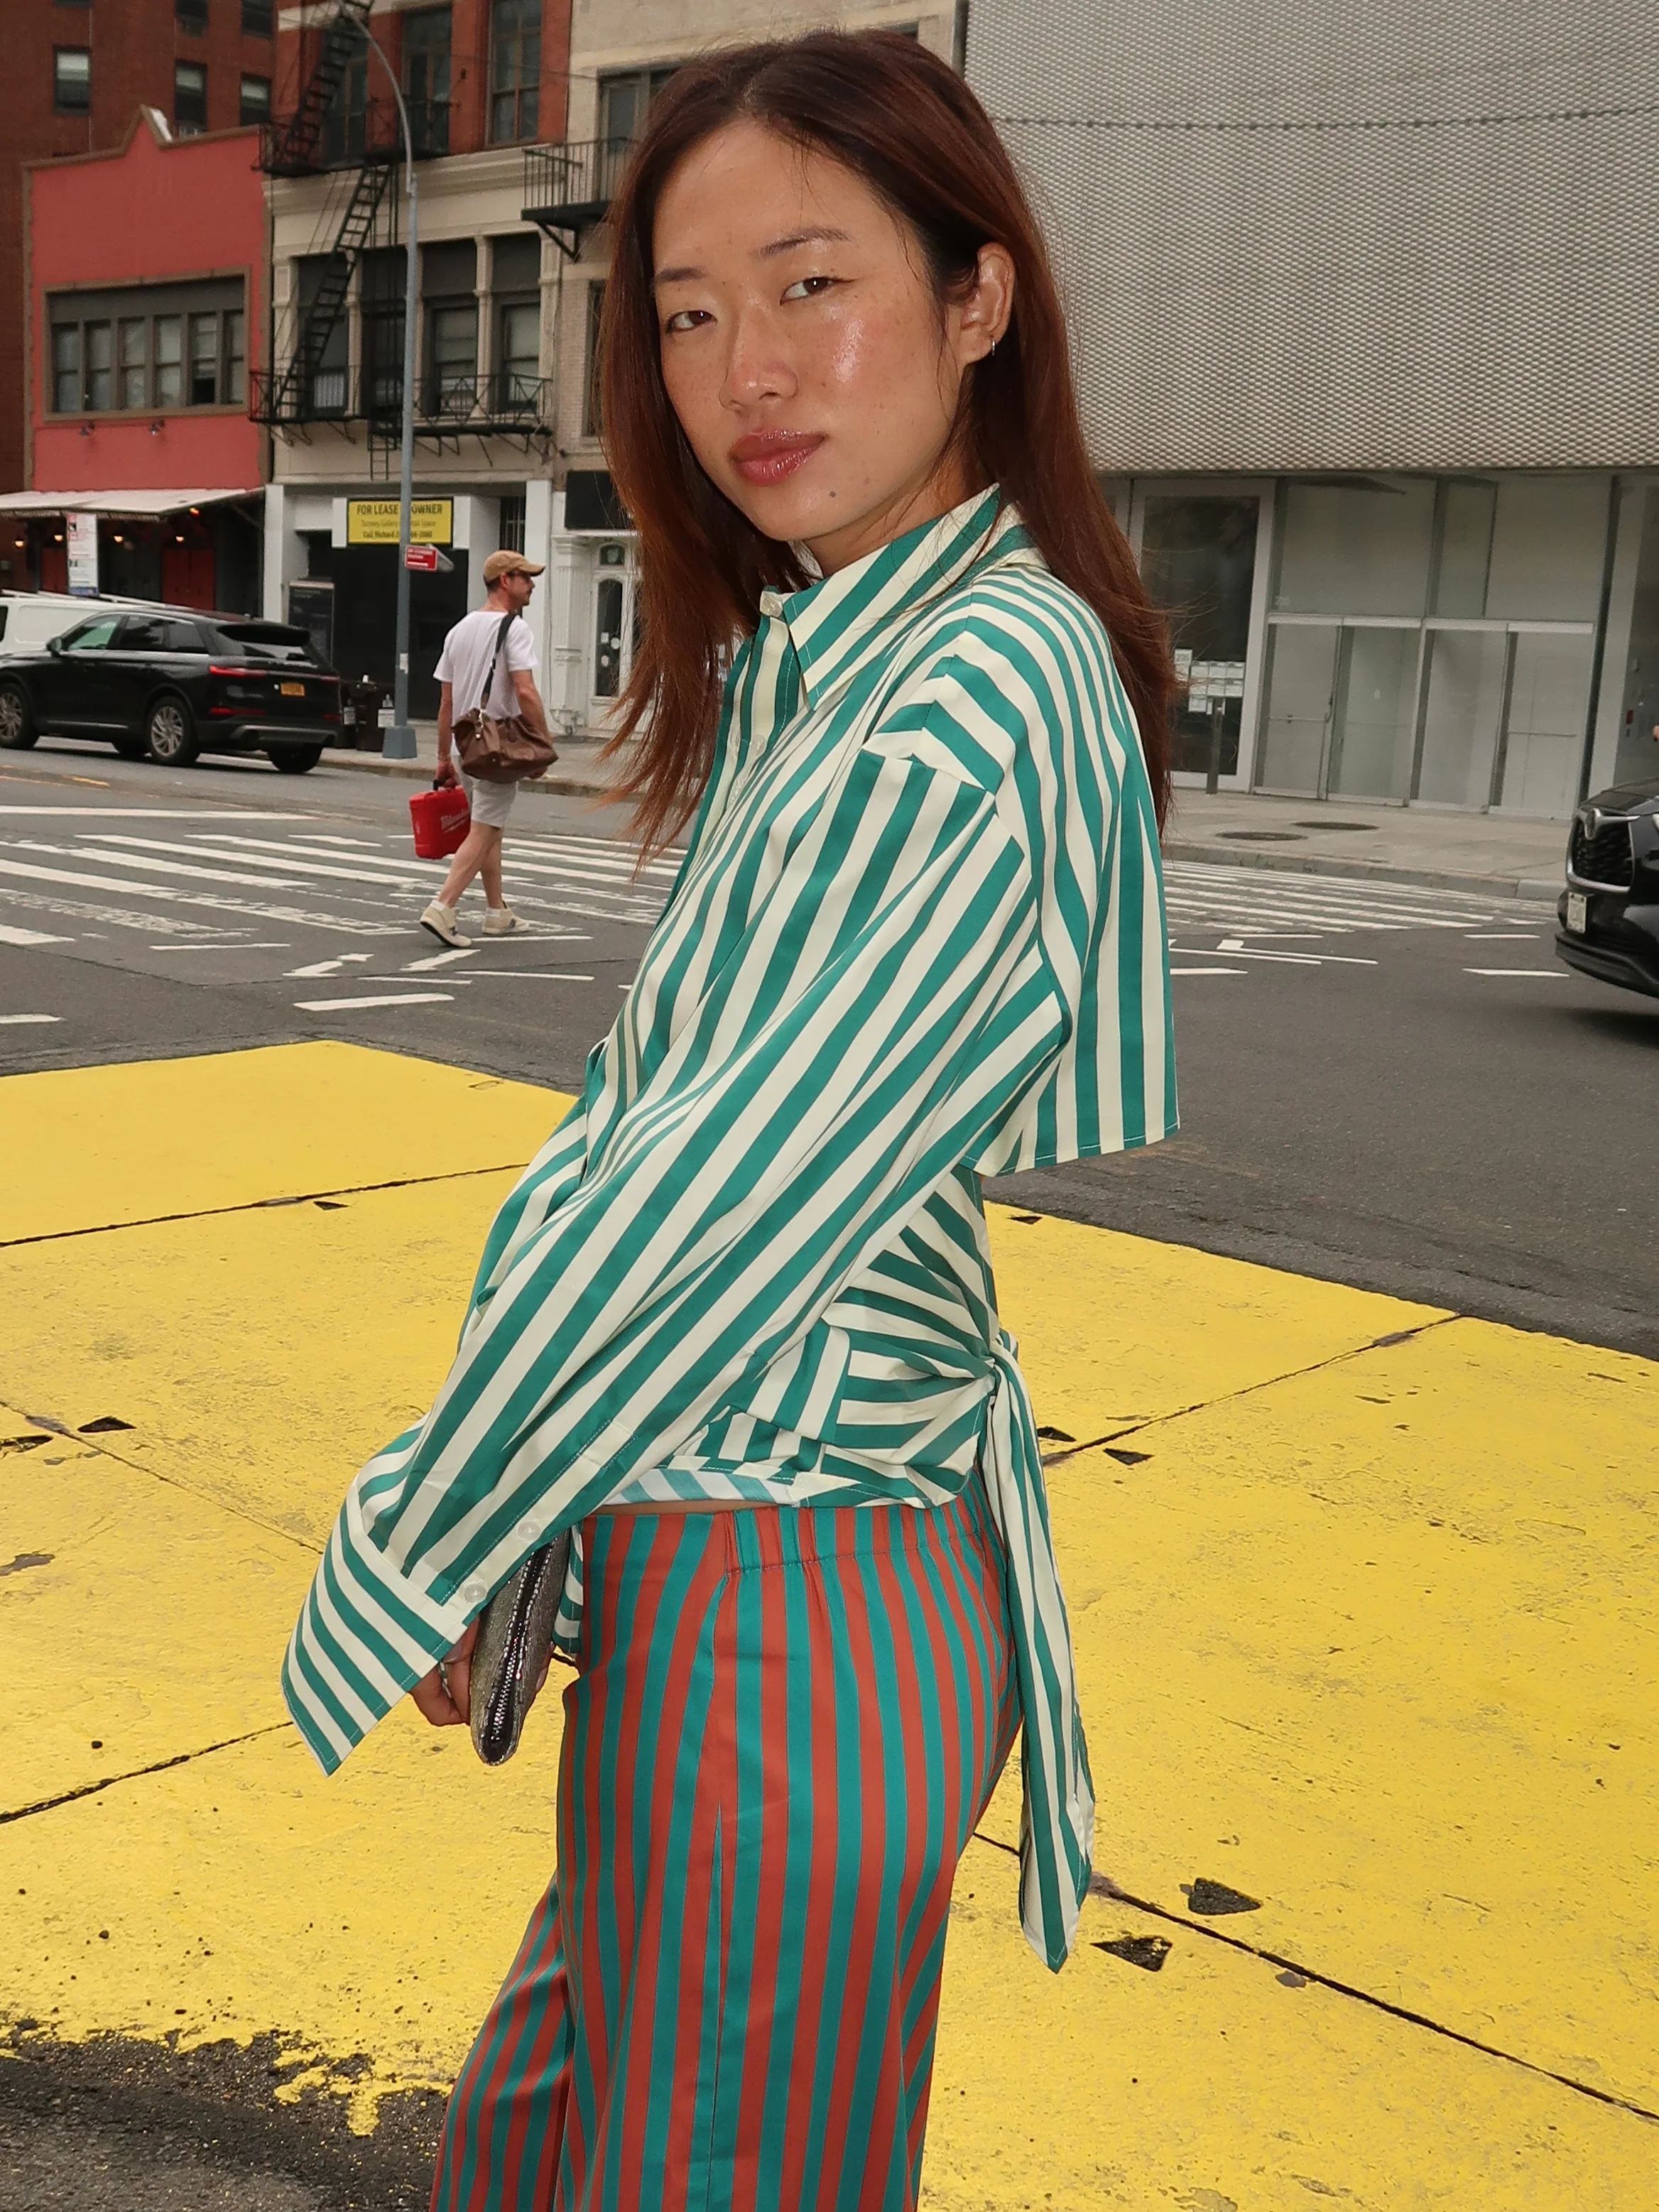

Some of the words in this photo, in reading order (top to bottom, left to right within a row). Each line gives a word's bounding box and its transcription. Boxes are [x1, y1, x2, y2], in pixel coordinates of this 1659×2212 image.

[357, 504, 372, 515] FOR
[374, 503, 399, 515] LEASE
[411, 503, 443, 514] OWNER
